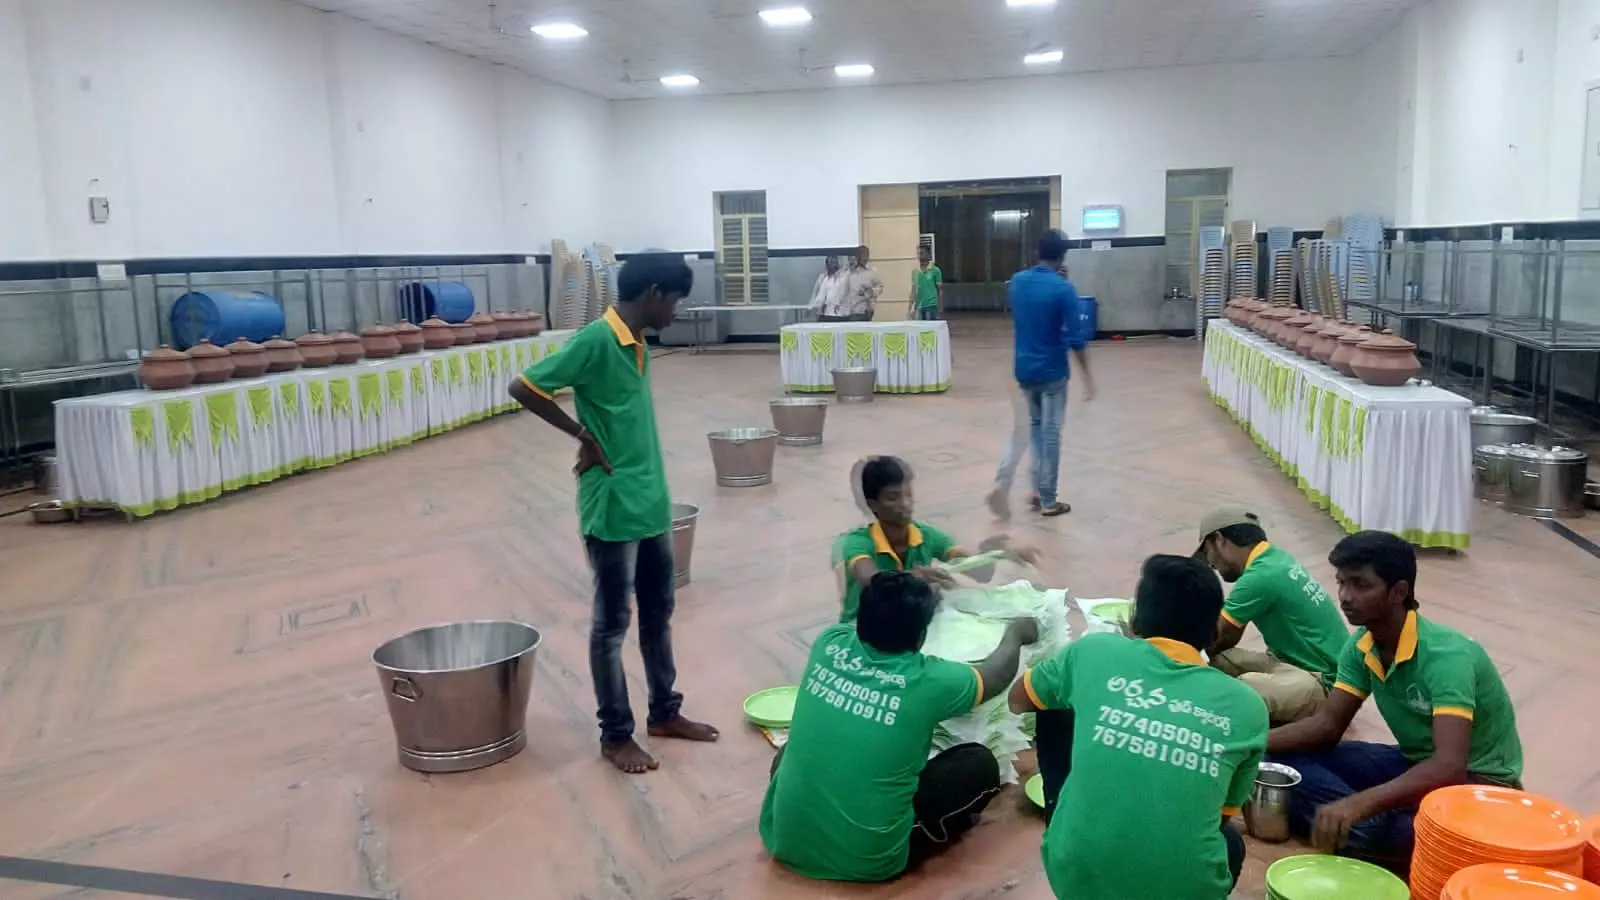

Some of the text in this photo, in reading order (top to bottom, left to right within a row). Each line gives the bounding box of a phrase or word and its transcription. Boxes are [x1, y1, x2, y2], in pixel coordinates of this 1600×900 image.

[805, 678, 896, 725] 7675810916
[811, 663, 901, 710] 7674050916
[1107, 676, 1166, 709] అర్చన
[1092, 725, 1220, 777] 7675810916
